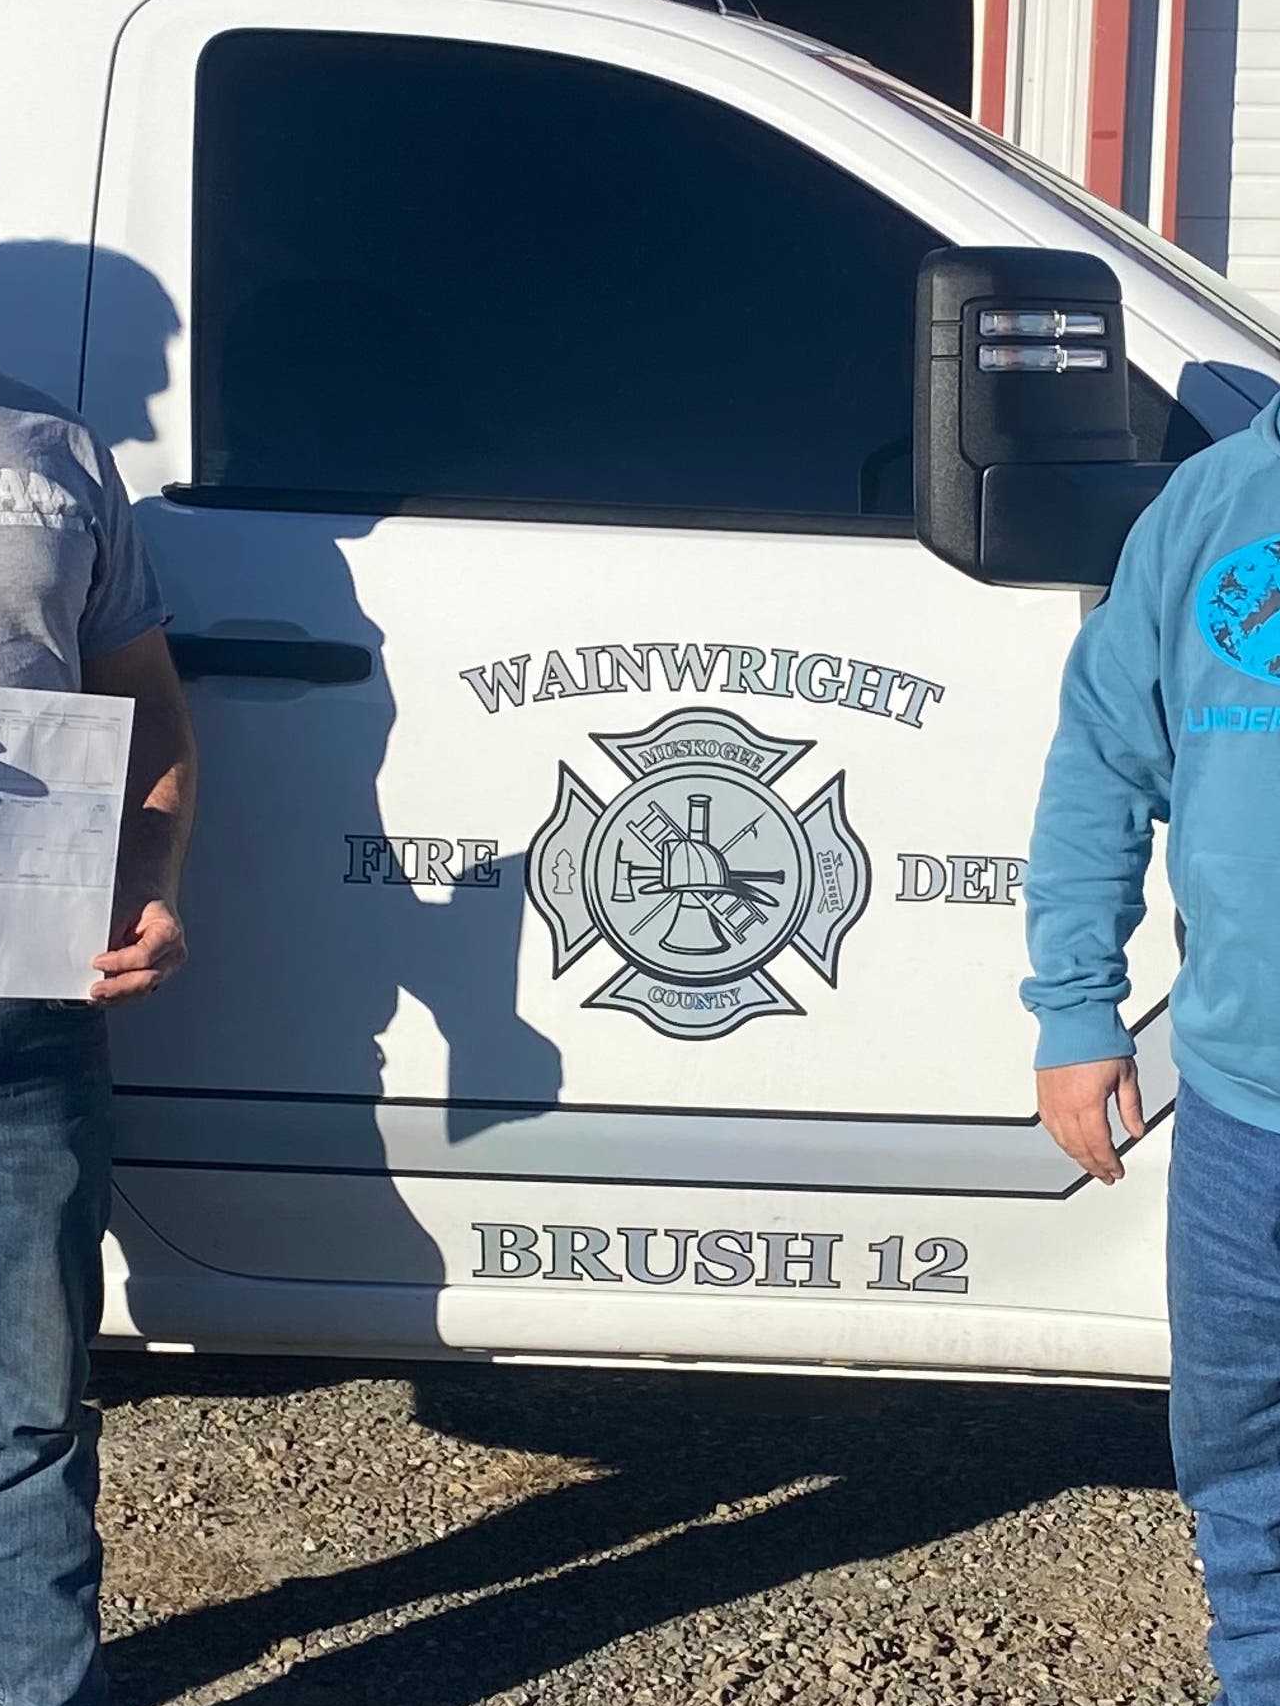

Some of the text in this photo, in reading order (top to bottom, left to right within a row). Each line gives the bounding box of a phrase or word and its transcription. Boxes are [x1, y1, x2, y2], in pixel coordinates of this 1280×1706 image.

[459, 641, 946, 730] WAINWRIGHT
[639, 739, 765, 773] MUSKOGEE
[343, 834, 1029, 906] FIRE DEP
[647, 985, 742, 1010] COUNTY
[470, 1221, 970, 1294] BRUSH 12
